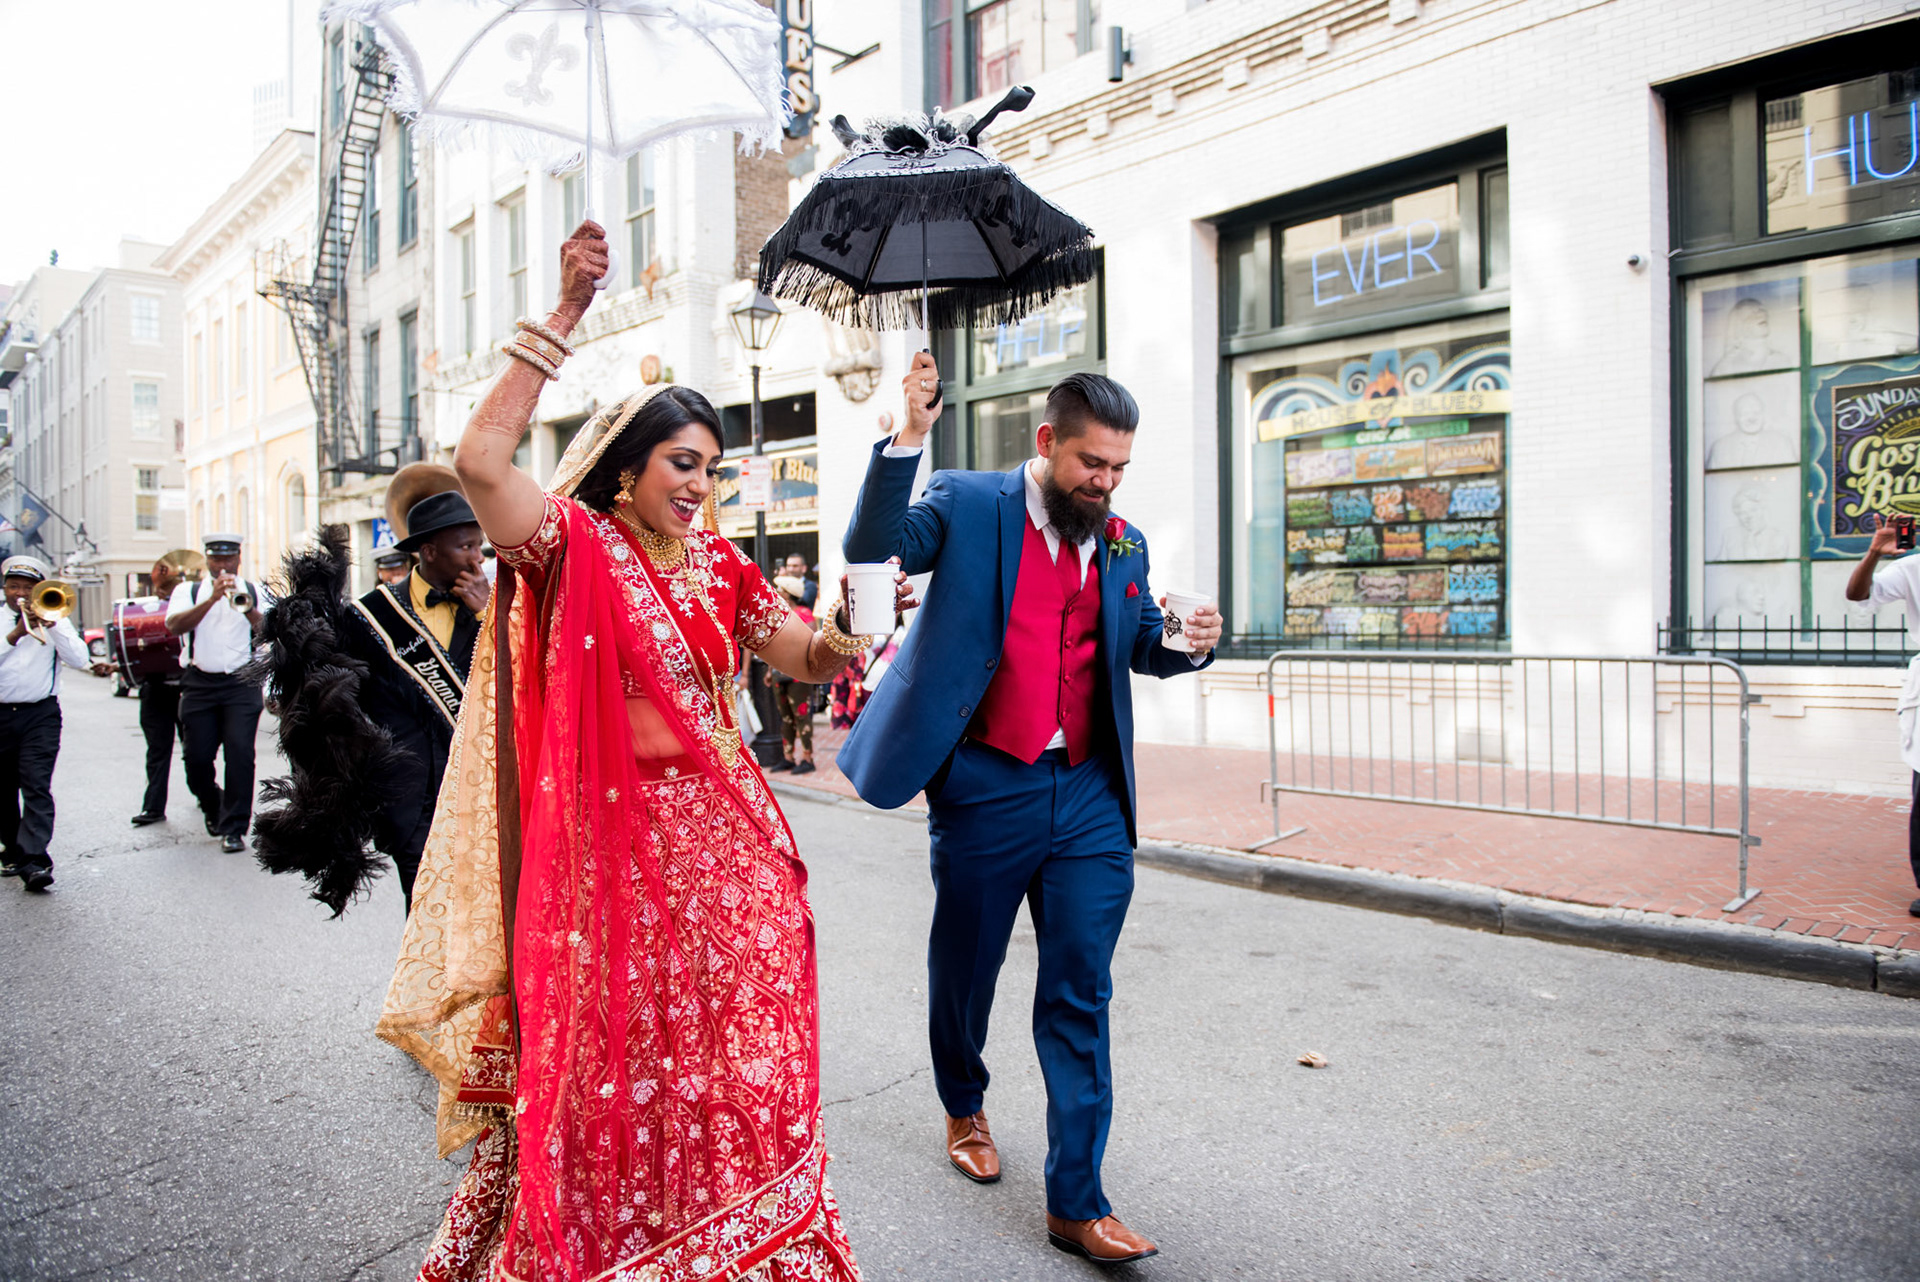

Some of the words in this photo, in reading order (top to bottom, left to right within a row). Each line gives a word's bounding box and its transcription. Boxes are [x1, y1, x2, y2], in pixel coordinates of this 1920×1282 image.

[1804, 100, 1918, 195] HU
[1312, 219, 1443, 307] EVER
[1292, 404, 1358, 431] HOUSE
[1411, 393, 1485, 413] BLUES
[414, 657, 462, 712] Grand
